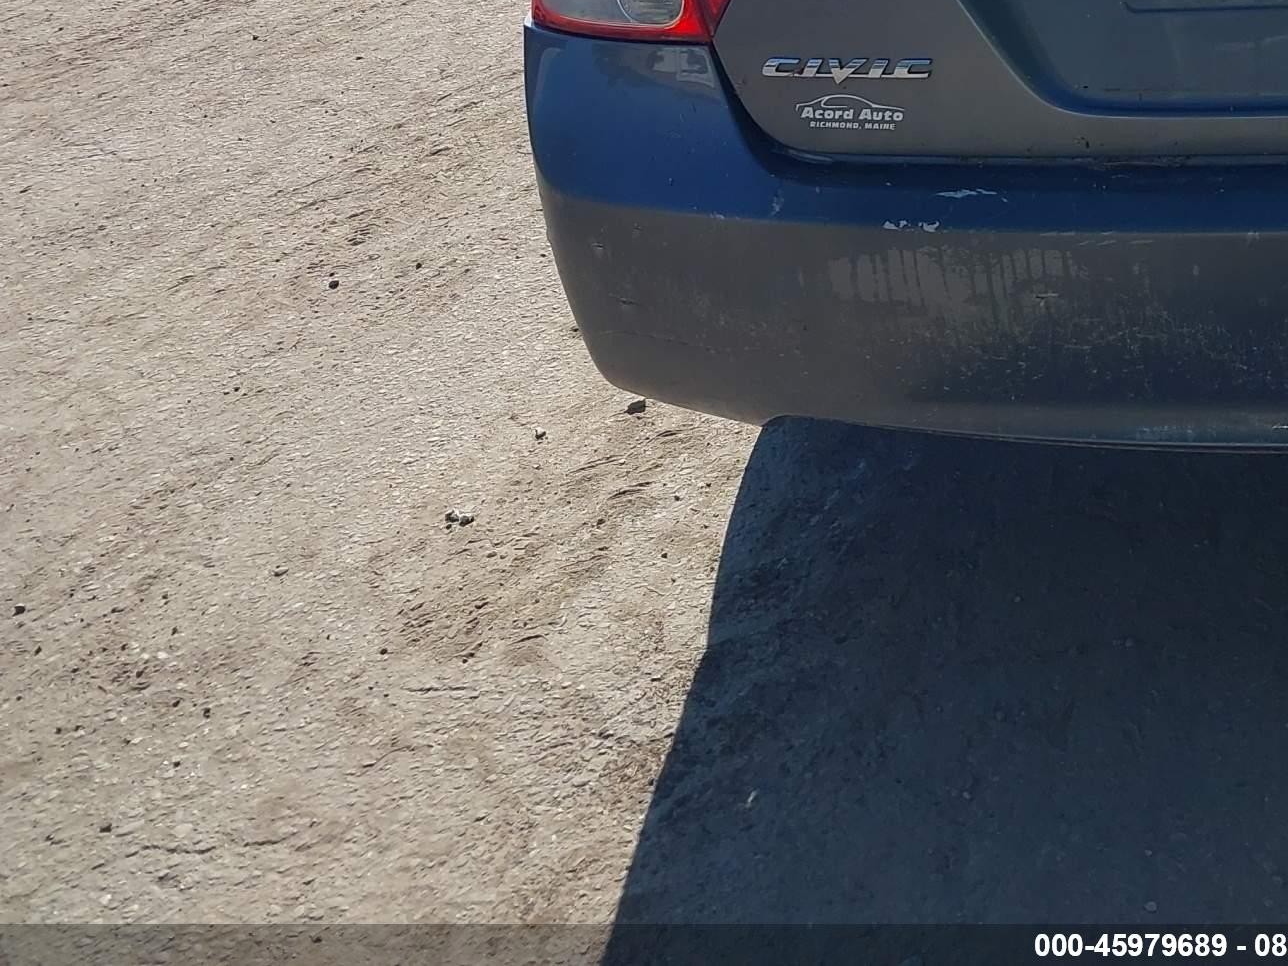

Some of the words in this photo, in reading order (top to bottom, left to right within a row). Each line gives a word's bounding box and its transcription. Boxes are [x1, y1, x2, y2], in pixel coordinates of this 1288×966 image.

[762, 57, 931, 85] CIVIC
[801, 107, 853, 120] Acord
[859, 108, 904, 121] Auto
[865, 122, 897, 131] MAINE
